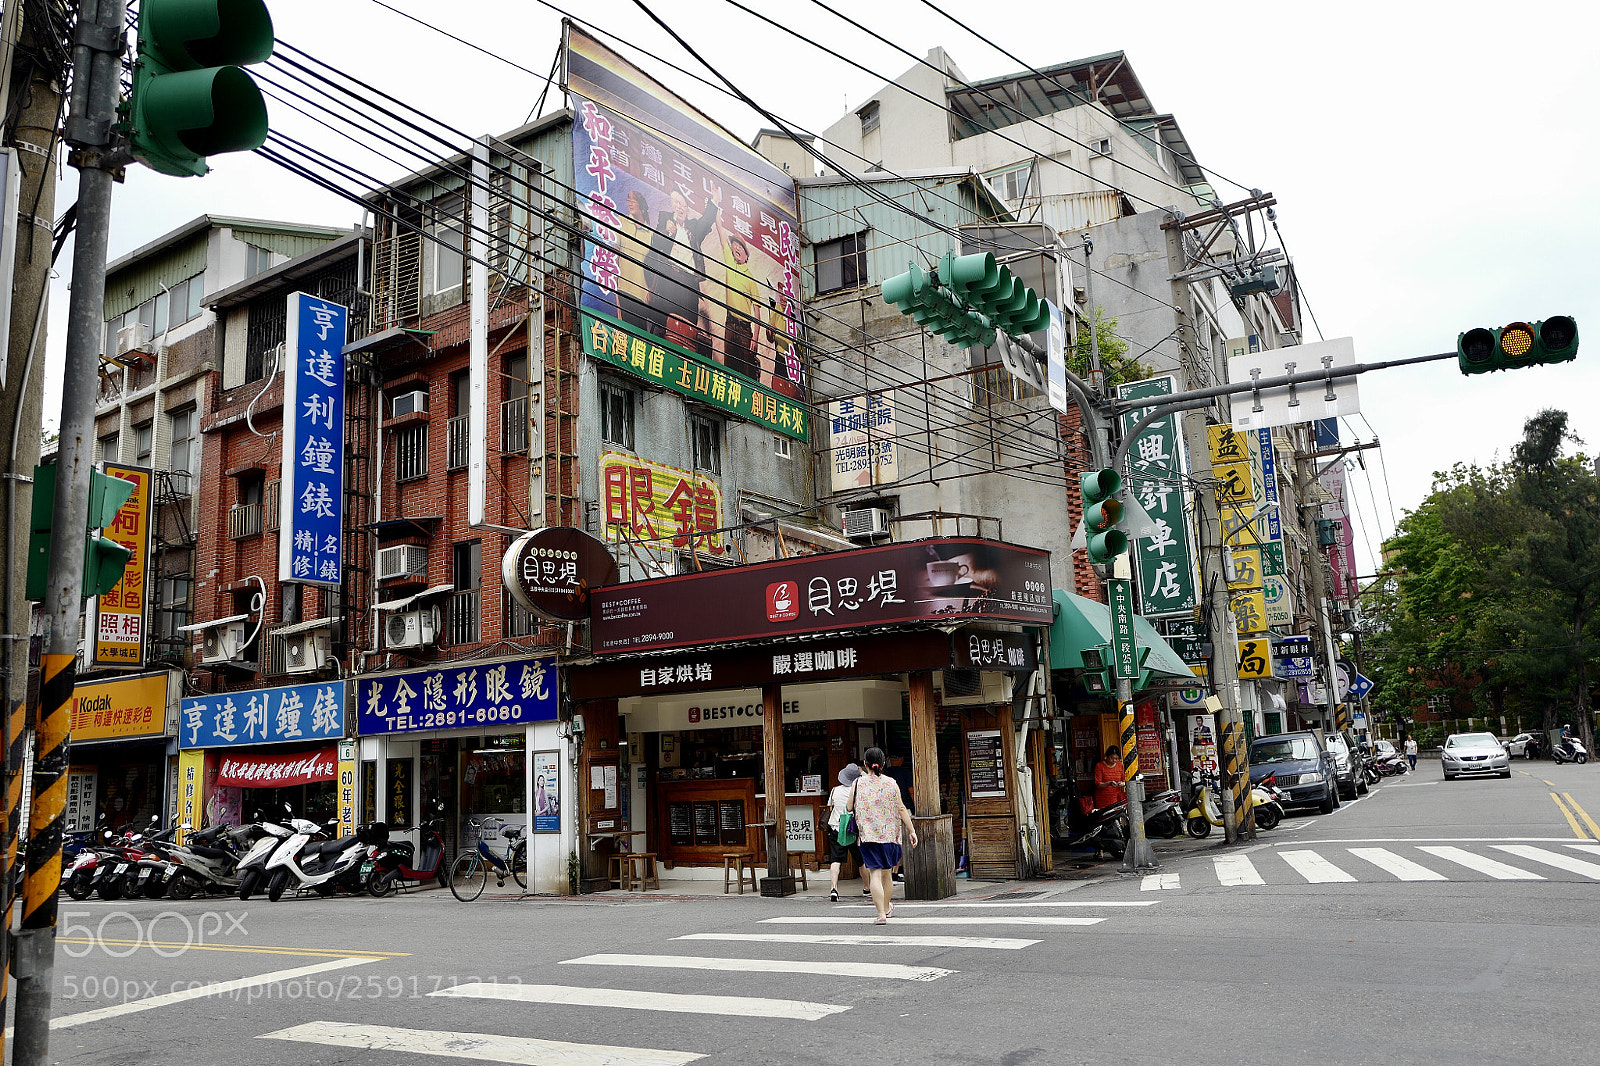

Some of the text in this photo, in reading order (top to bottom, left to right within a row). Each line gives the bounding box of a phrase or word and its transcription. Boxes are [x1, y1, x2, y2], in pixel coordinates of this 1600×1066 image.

[299, 303, 339, 519] 亨達利鐘錶
[833, 408, 892, 434] 動物醫院
[605, 465, 724, 554] 眼鏡
[292, 529, 313, 577] 精修
[319, 534, 339, 580] 名錶
[524, 556, 580, 586] 貝思堤
[102, 581, 119, 608] 速
[124, 570, 141, 609] 彩色
[808, 569, 906, 617] 貝思堤
[100, 614, 140, 635] 照相
[1116, 594, 1132, 675] 中央南路一段25巷
[100, 647, 138, 658] 大學城店
[772, 647, 858, 675] 嚴選咖啡
[365, 660, 549, 717] 光全隱形眼鏡
[80, 694, 112, 713] Kodak
[93, 706, 153, 728] 柯達快速彩色
[183, 686, 340, 745] 亨達利鐘錶
[386, 704, 522, 730] TEL:2891-6080
[703, 700, 800, 720] BEST COEE
[345, 748, 350, 757] 6
[789, 833, 813, 841] COFFEE
